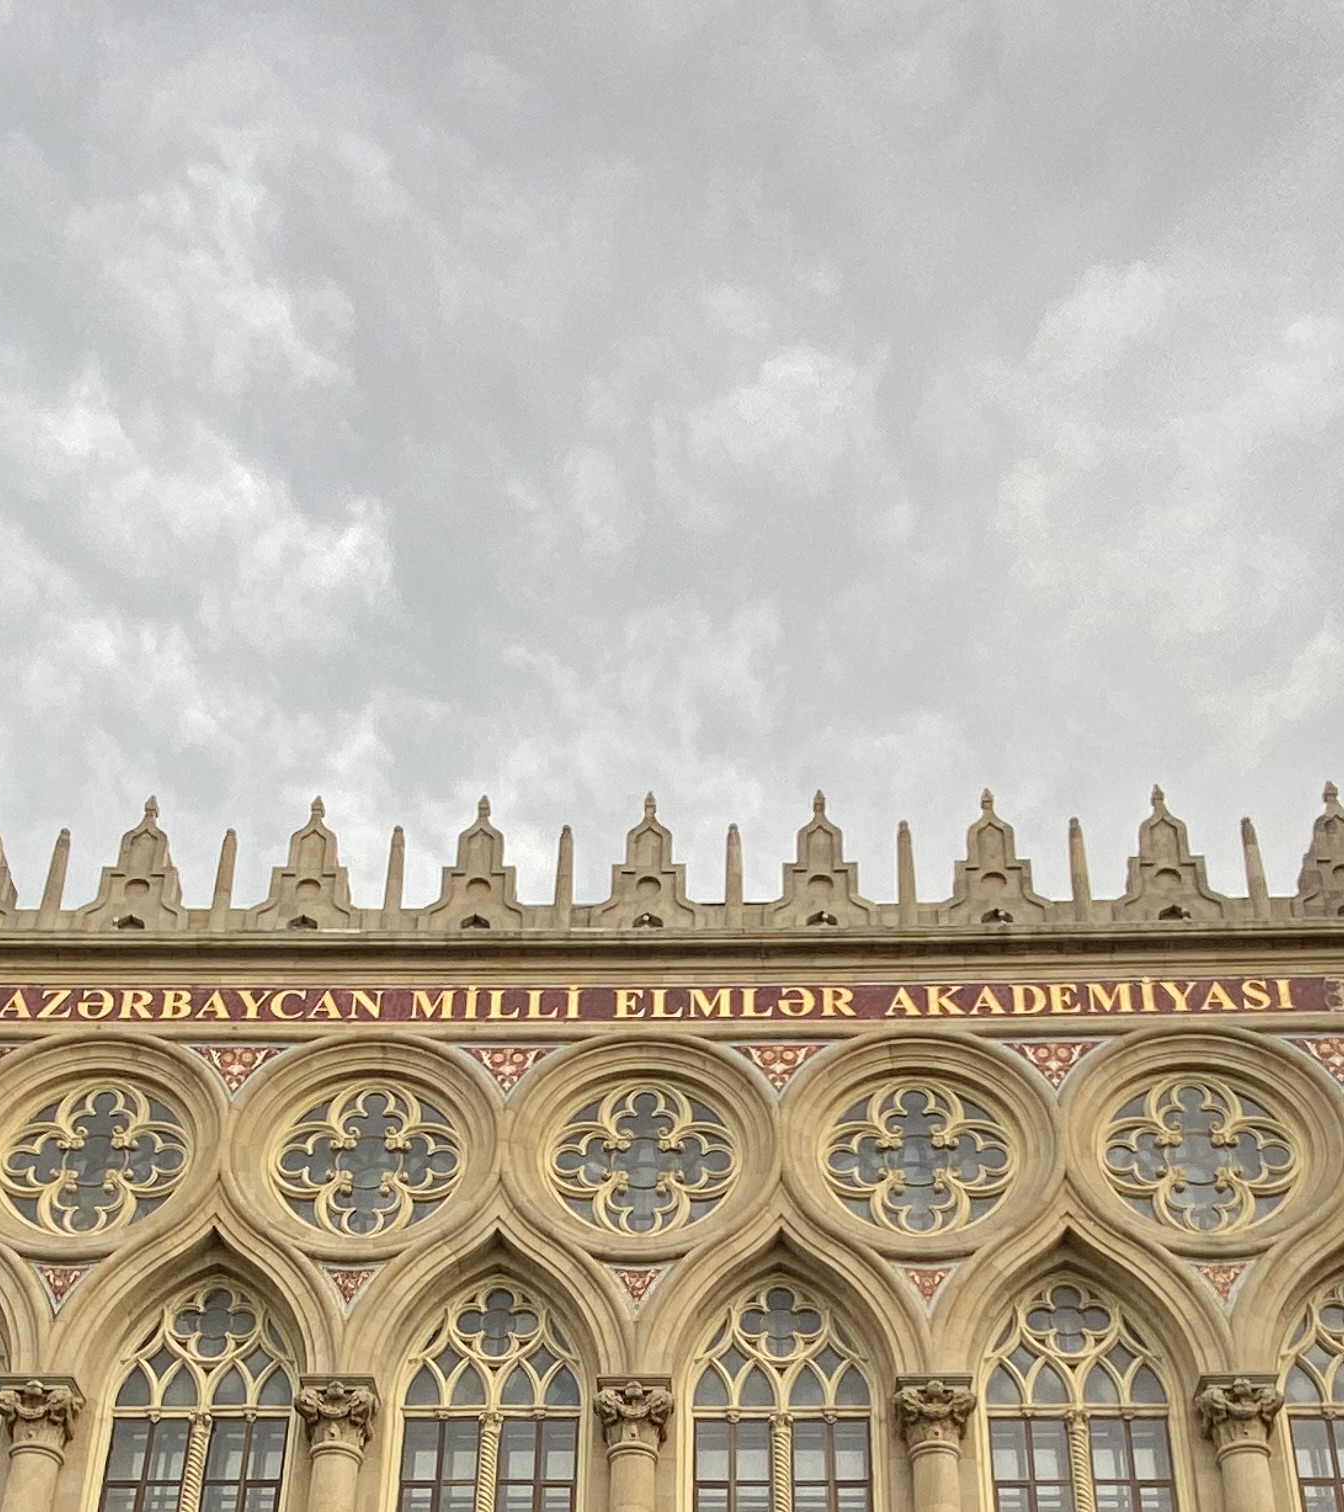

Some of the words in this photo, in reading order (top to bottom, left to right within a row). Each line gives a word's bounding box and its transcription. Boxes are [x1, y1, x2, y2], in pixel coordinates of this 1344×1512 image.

[409, 985, 581, 1020] MİLLİ
[612, 986, 857, 1019] ELMLƏR
[884, 976, 1295, 1017] AKADEMİYASI
